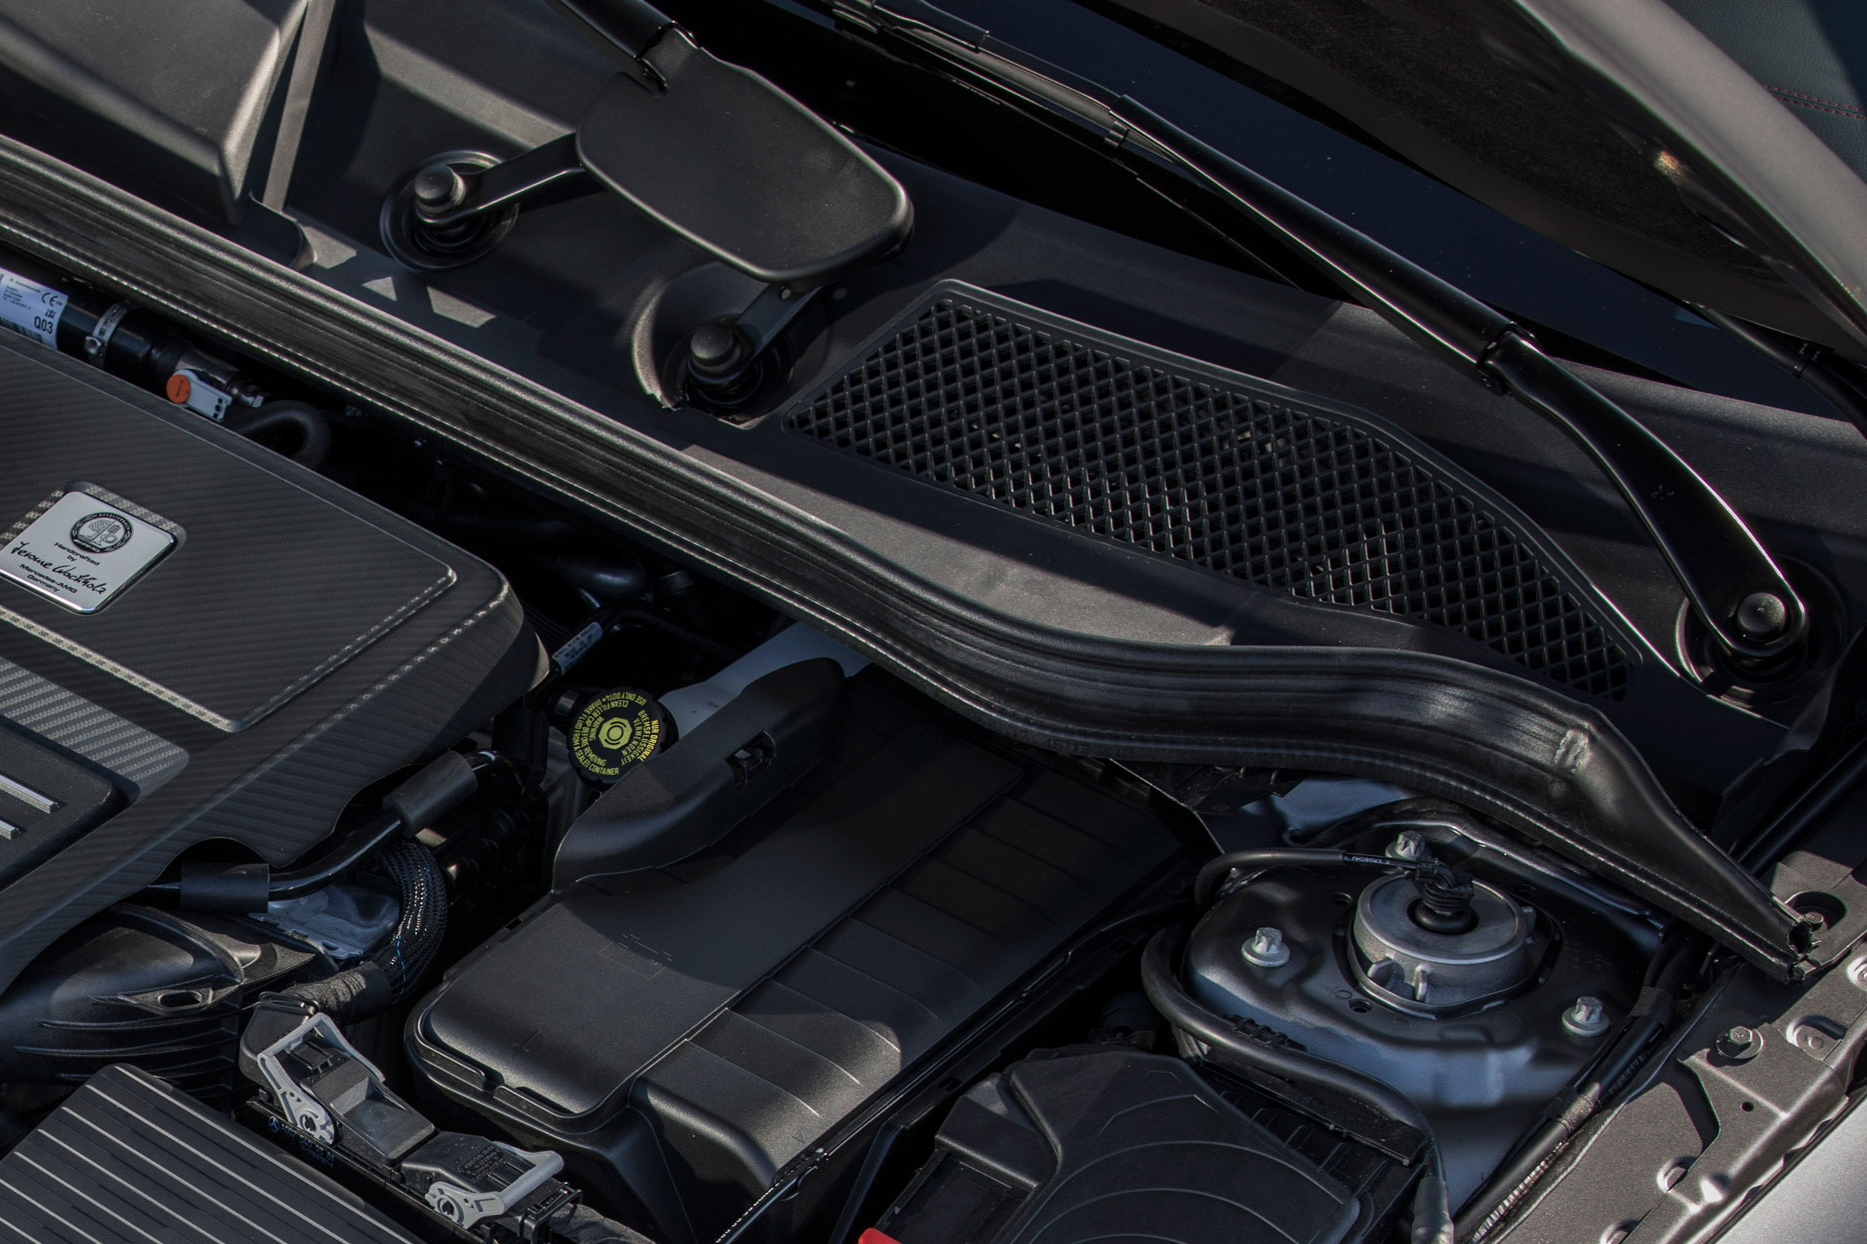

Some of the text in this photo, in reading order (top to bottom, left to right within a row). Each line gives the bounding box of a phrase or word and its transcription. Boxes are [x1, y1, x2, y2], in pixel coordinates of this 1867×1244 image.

[34, 316, 54, 334] Q03
[54, 542, 101, 566] Handcrafted
[20, 564, 78, 593] Mercedes-AMG
[27, 574, 60, 592] Germany
[637, 734, 658, 761] ORIGINAL
